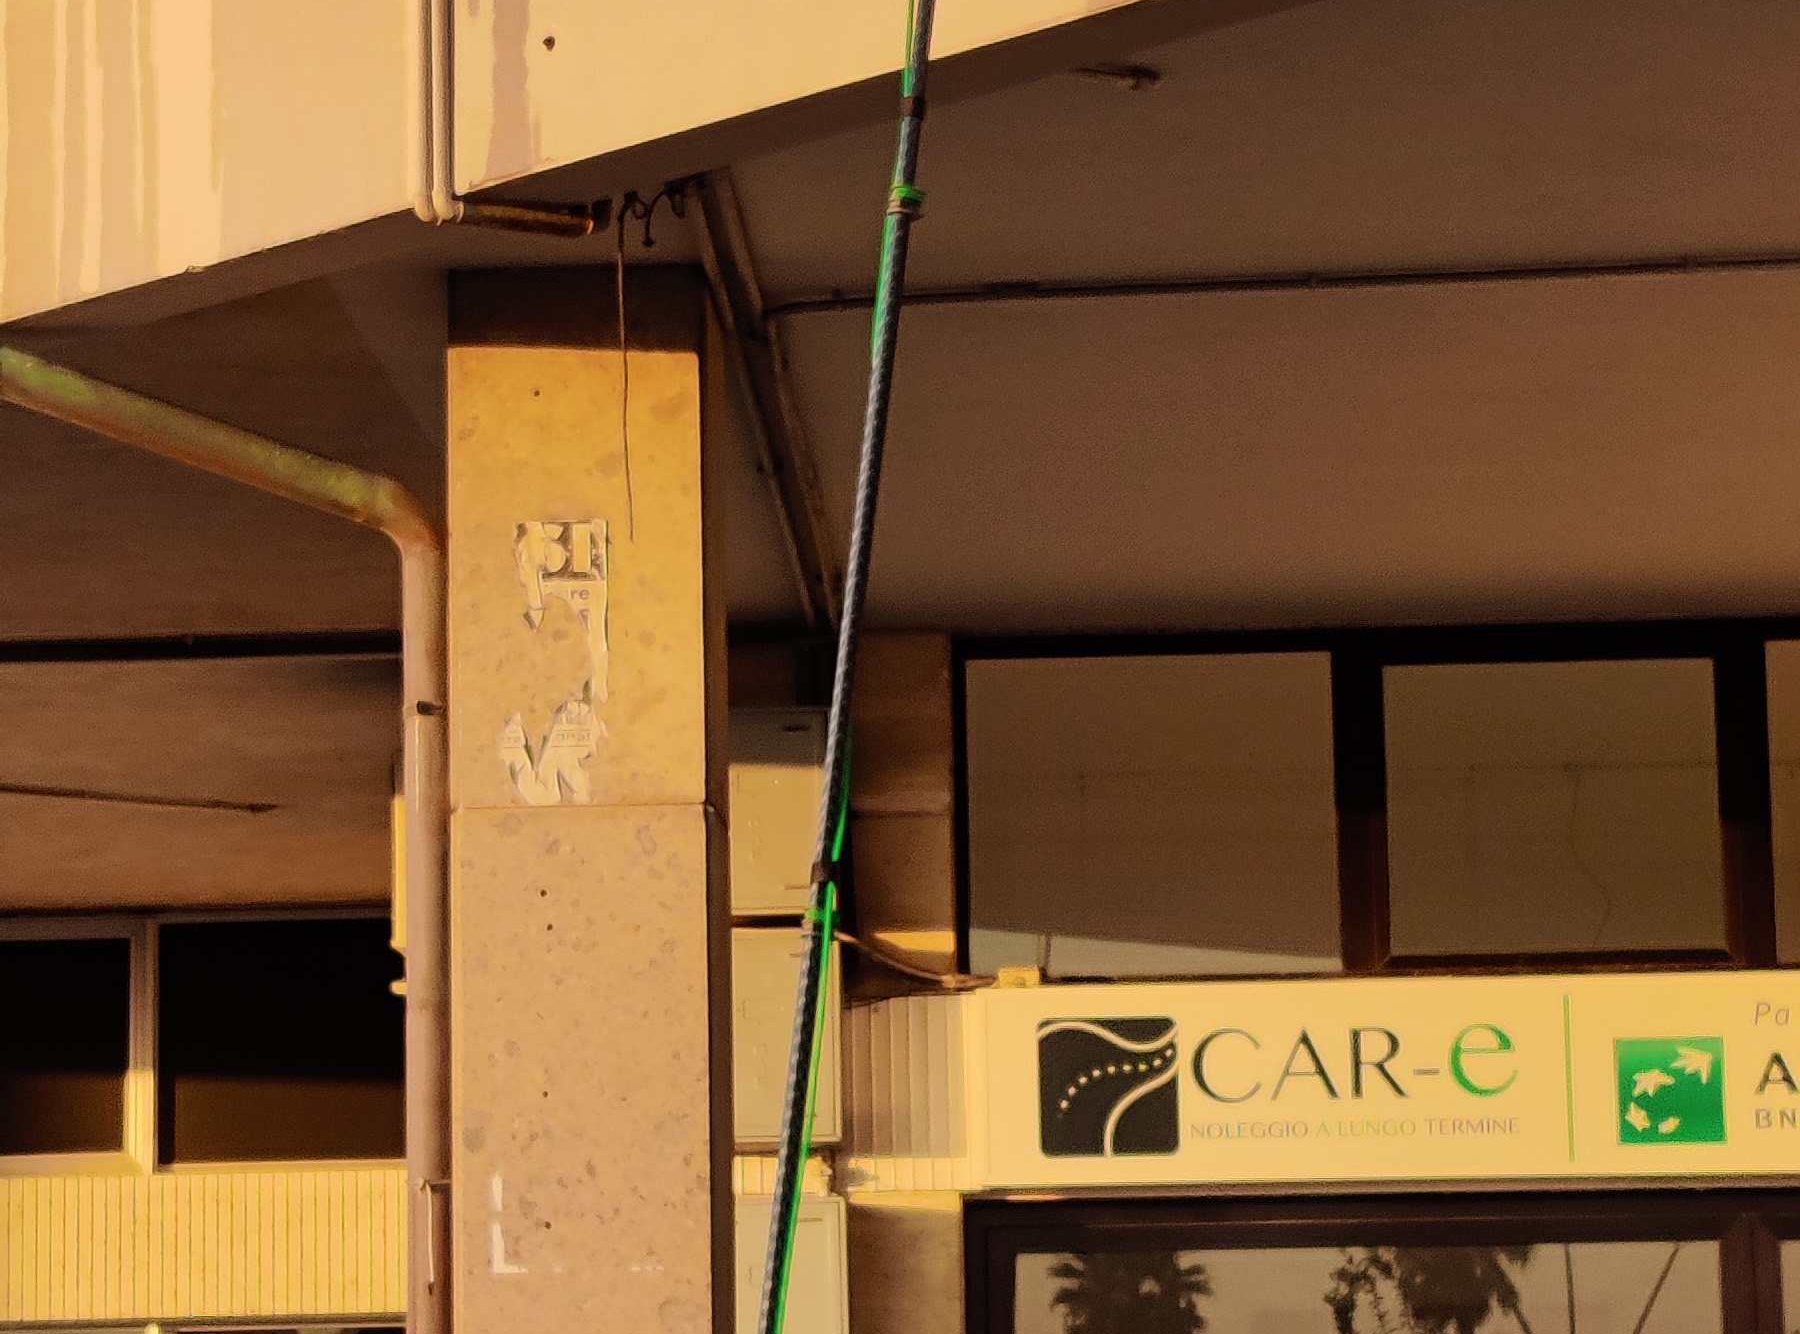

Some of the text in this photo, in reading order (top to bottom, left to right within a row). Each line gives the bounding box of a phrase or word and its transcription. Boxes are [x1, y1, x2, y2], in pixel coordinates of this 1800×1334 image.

[1754, 1002, 1790, 1025] Pa
[1191, 1023, 1518, 1103] CAR-e
[1753, 1051, 1800, 1094] A
[1190, 1117, 1521, 1139] NOLEGGIO A LUNGO TERMINE
[1755, 1108, 1797, 1129] BN
